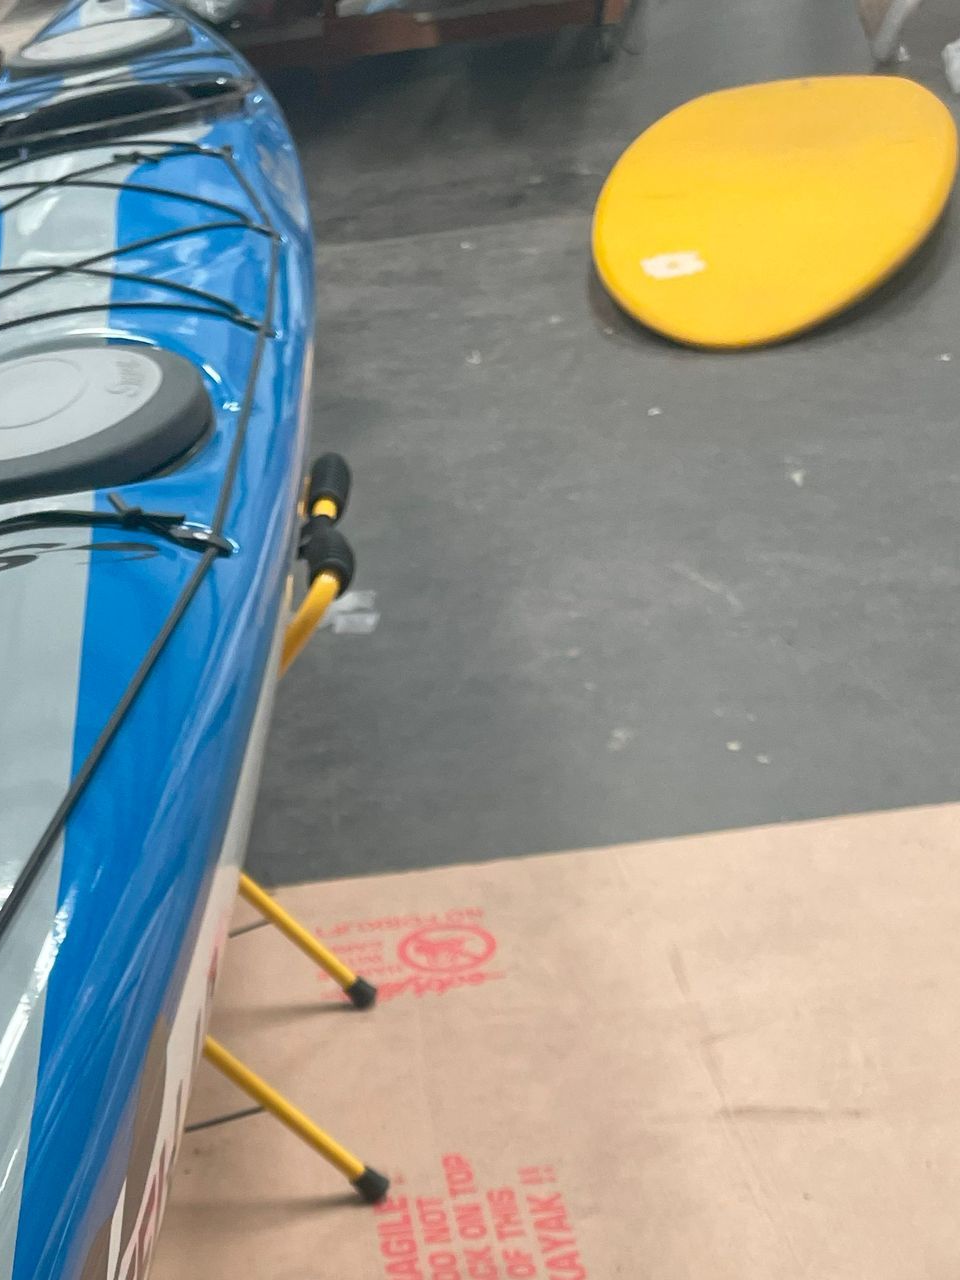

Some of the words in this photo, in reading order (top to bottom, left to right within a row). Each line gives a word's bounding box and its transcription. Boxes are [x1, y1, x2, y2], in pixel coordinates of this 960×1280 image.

[442, 1153, 477, 1199] TOP
[416, 1197, 452, 1245] NOT
[452, 1204, 488, 1241] ON
[486, 1187, 527, 1241] THIS
[502, 1249, 537, 1280] OF
